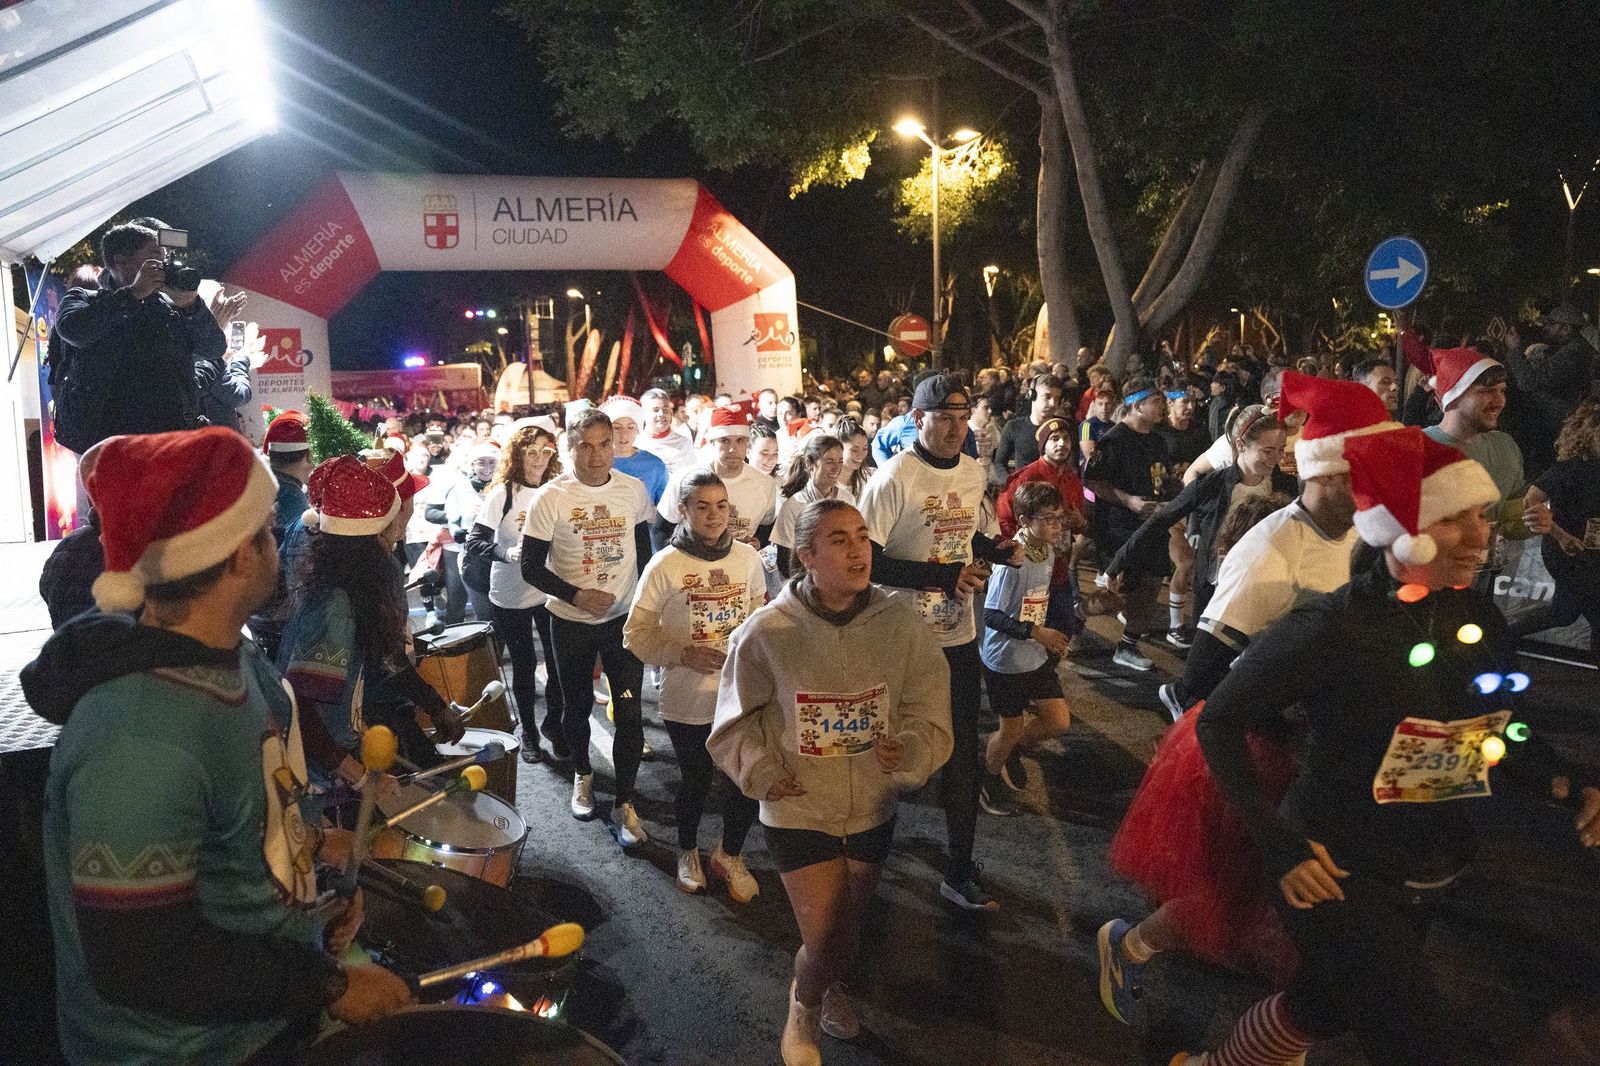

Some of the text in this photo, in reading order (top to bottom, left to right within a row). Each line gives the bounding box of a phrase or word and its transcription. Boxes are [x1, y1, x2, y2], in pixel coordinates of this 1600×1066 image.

[493, 192, 638, 222] ALMERÍA
[492, 228, 568, 245] CIUDAD
[280, 221, 343, 283] ALMERÍA
[697, 233, 753, 286] es deporte
[294, 234, 356, 295] es deporte
[258, 379, 305, 387] DEPORTES
[596, 545, 614, 555] 2005
[706, 607, 737, 623] 1451
[932, 603, 956, 615] 945
[820, 716, 870, 733] 1448
[1409, 750, 1474, 771] 2391
